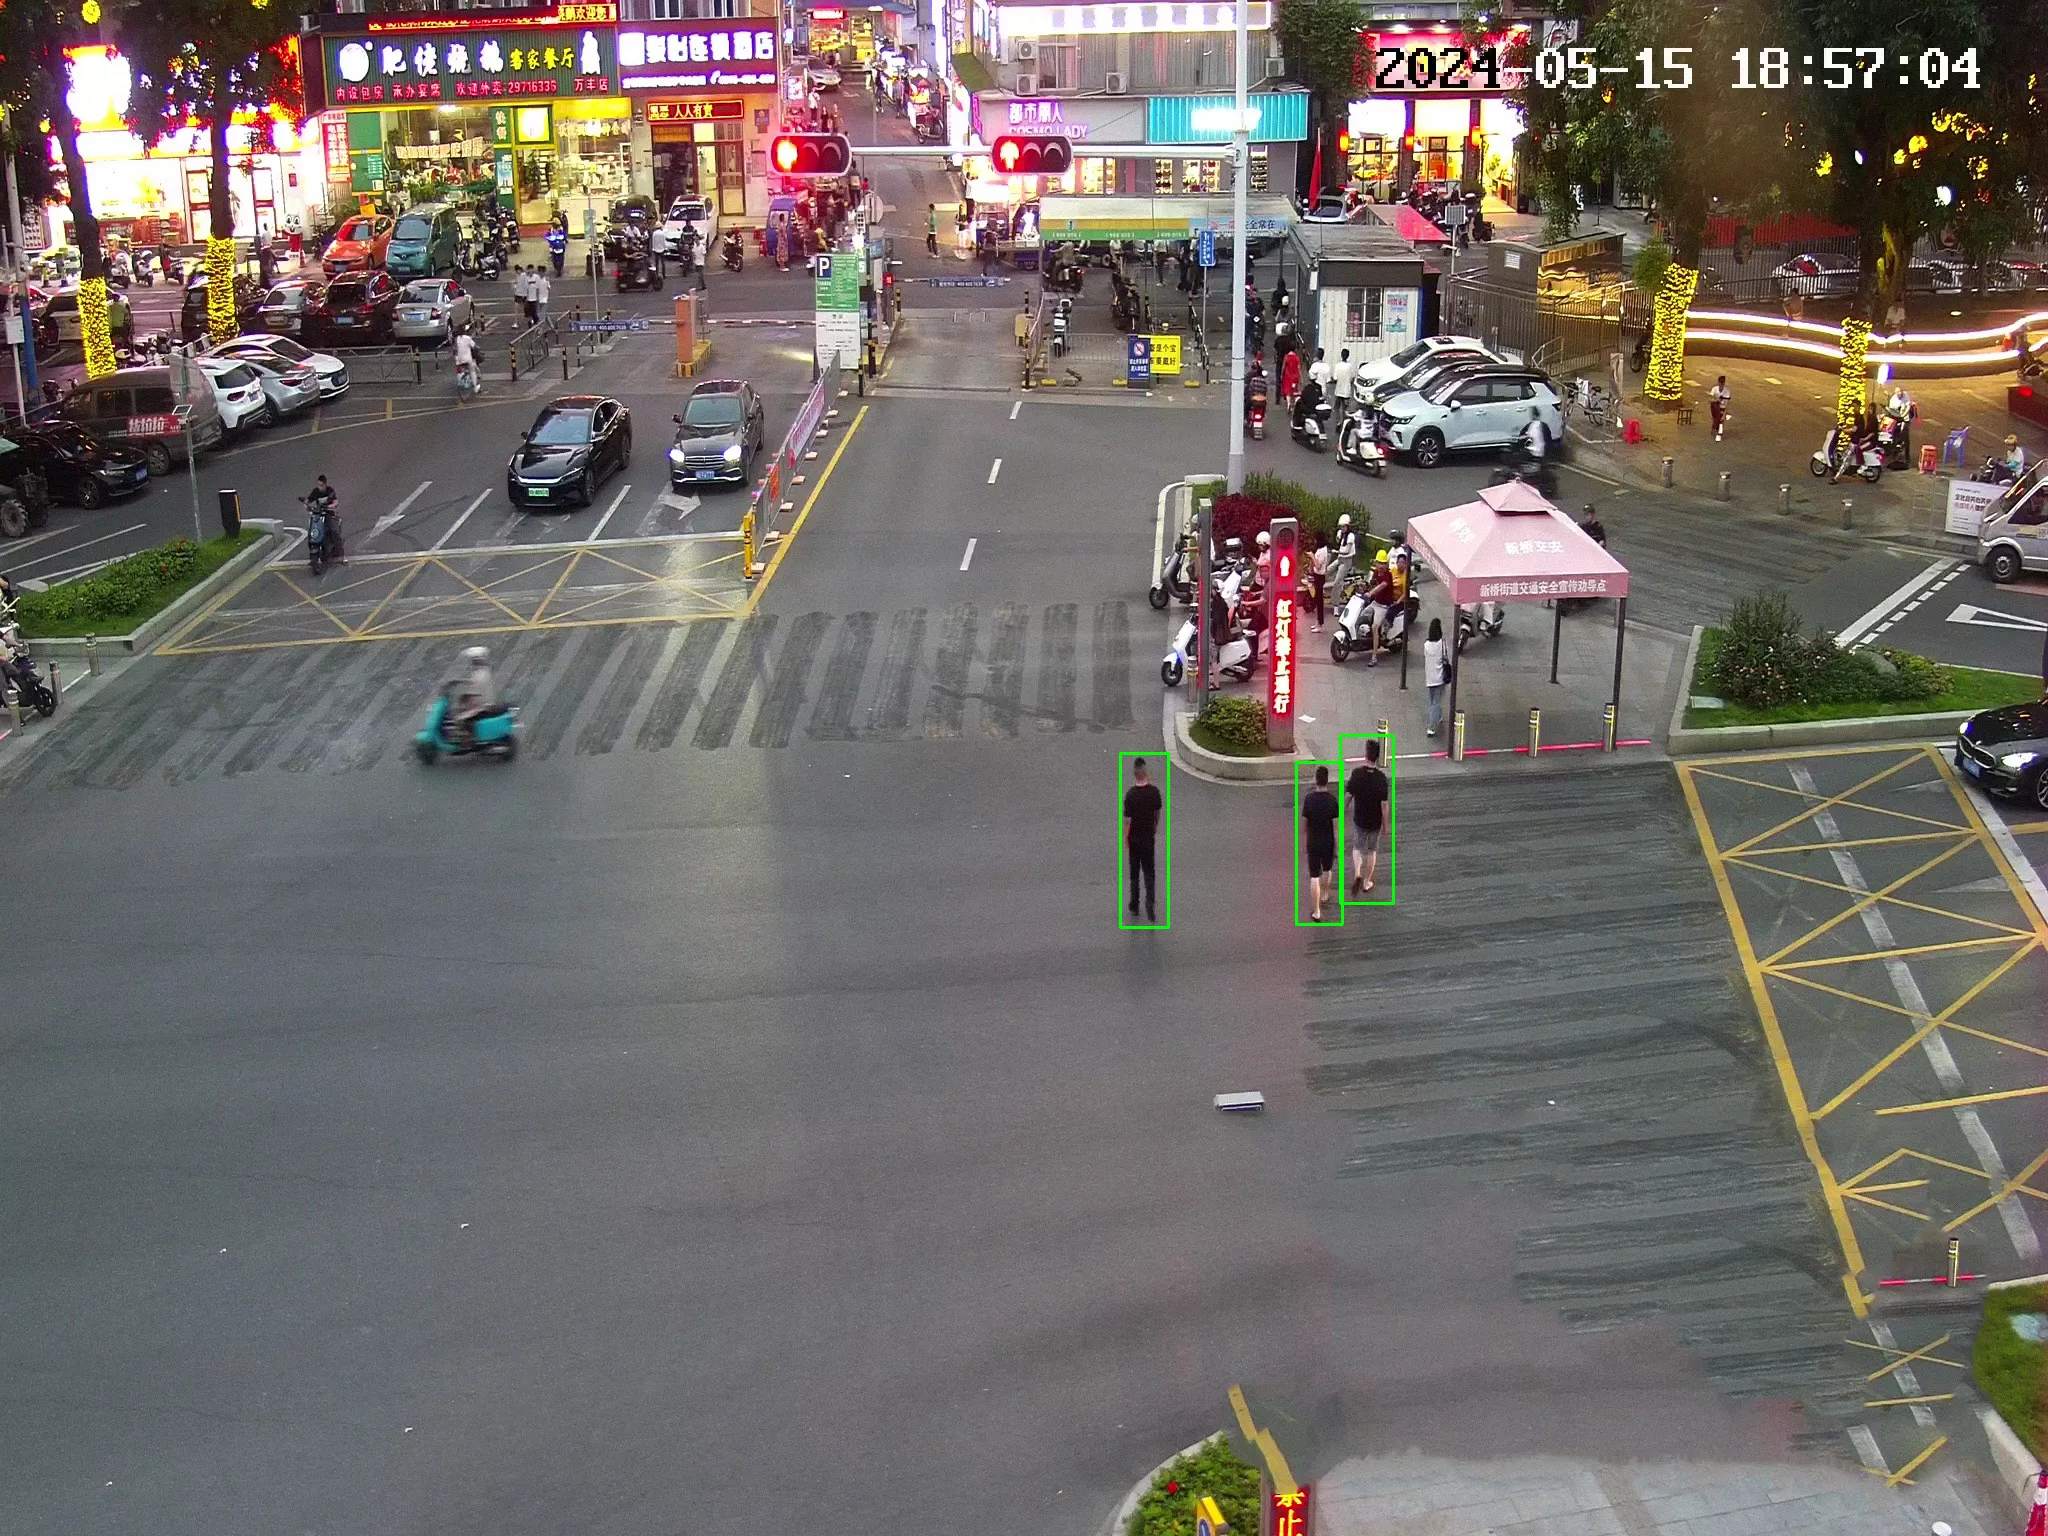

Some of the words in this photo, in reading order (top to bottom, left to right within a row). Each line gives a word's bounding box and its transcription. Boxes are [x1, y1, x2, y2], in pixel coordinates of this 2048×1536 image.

[510, 47, 575, 71] 客家餐厅
[574, 77, 608, 92] 万丰店
[1009, 102, 1063, 124] 都市丽人
[819, 257, 831, 277] P
[1480, 578, 1607, 597] 新桥街道交通安全宣传劝导点
[1274, 598, 1292, 714] 红灯禁止通行
